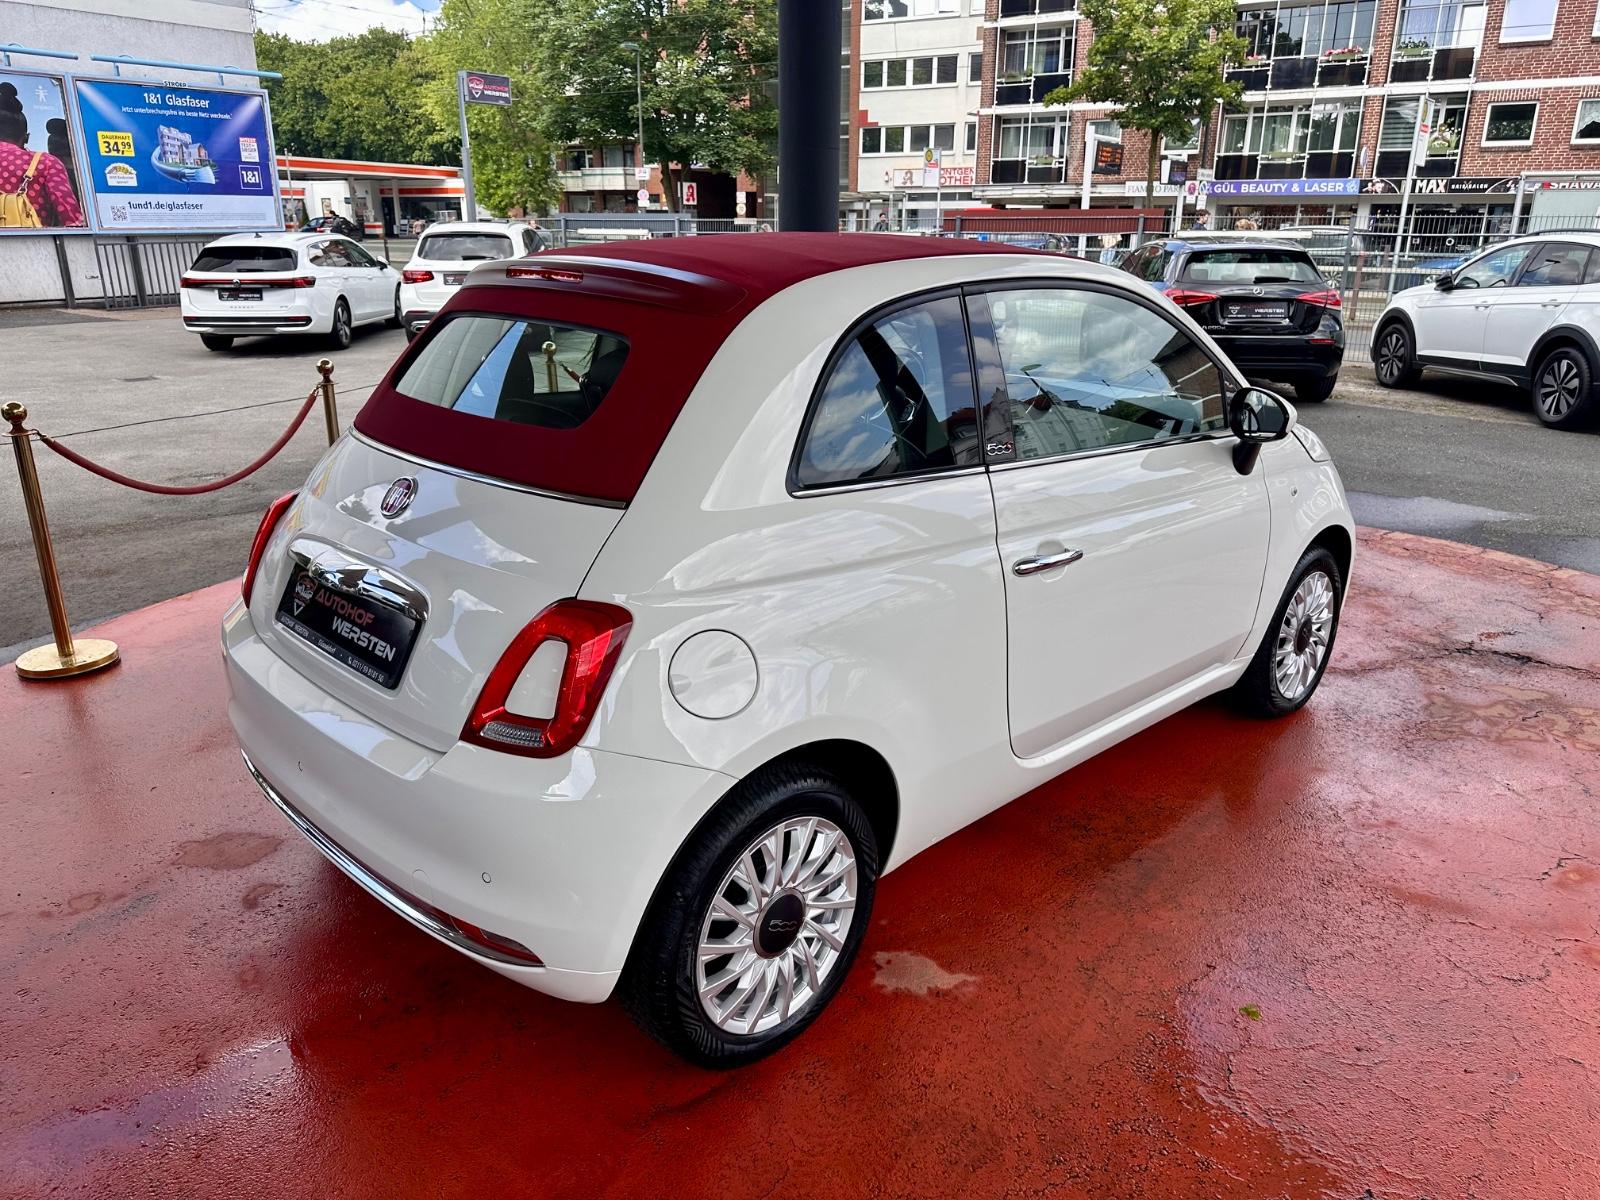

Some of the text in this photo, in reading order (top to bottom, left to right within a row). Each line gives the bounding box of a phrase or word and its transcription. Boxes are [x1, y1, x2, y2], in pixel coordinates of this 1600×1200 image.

[143, 93, 210, 109] 1&1 Glasfaser
[241, 170, 260, 183] 1&1
[1214, 182, 1344, 193] GÜL BEAUTY & LASER
[1415, 179, 1448, 193] MAX
[128, 201, 204, 212] 1und1.de/glasfaser
[986, 443, 1012, 456] 500
[315, 589, 376, 627] AUTOHOF
[332, 616, 396, 662] WERSTEN
[768, 919, 798, 932] 500
